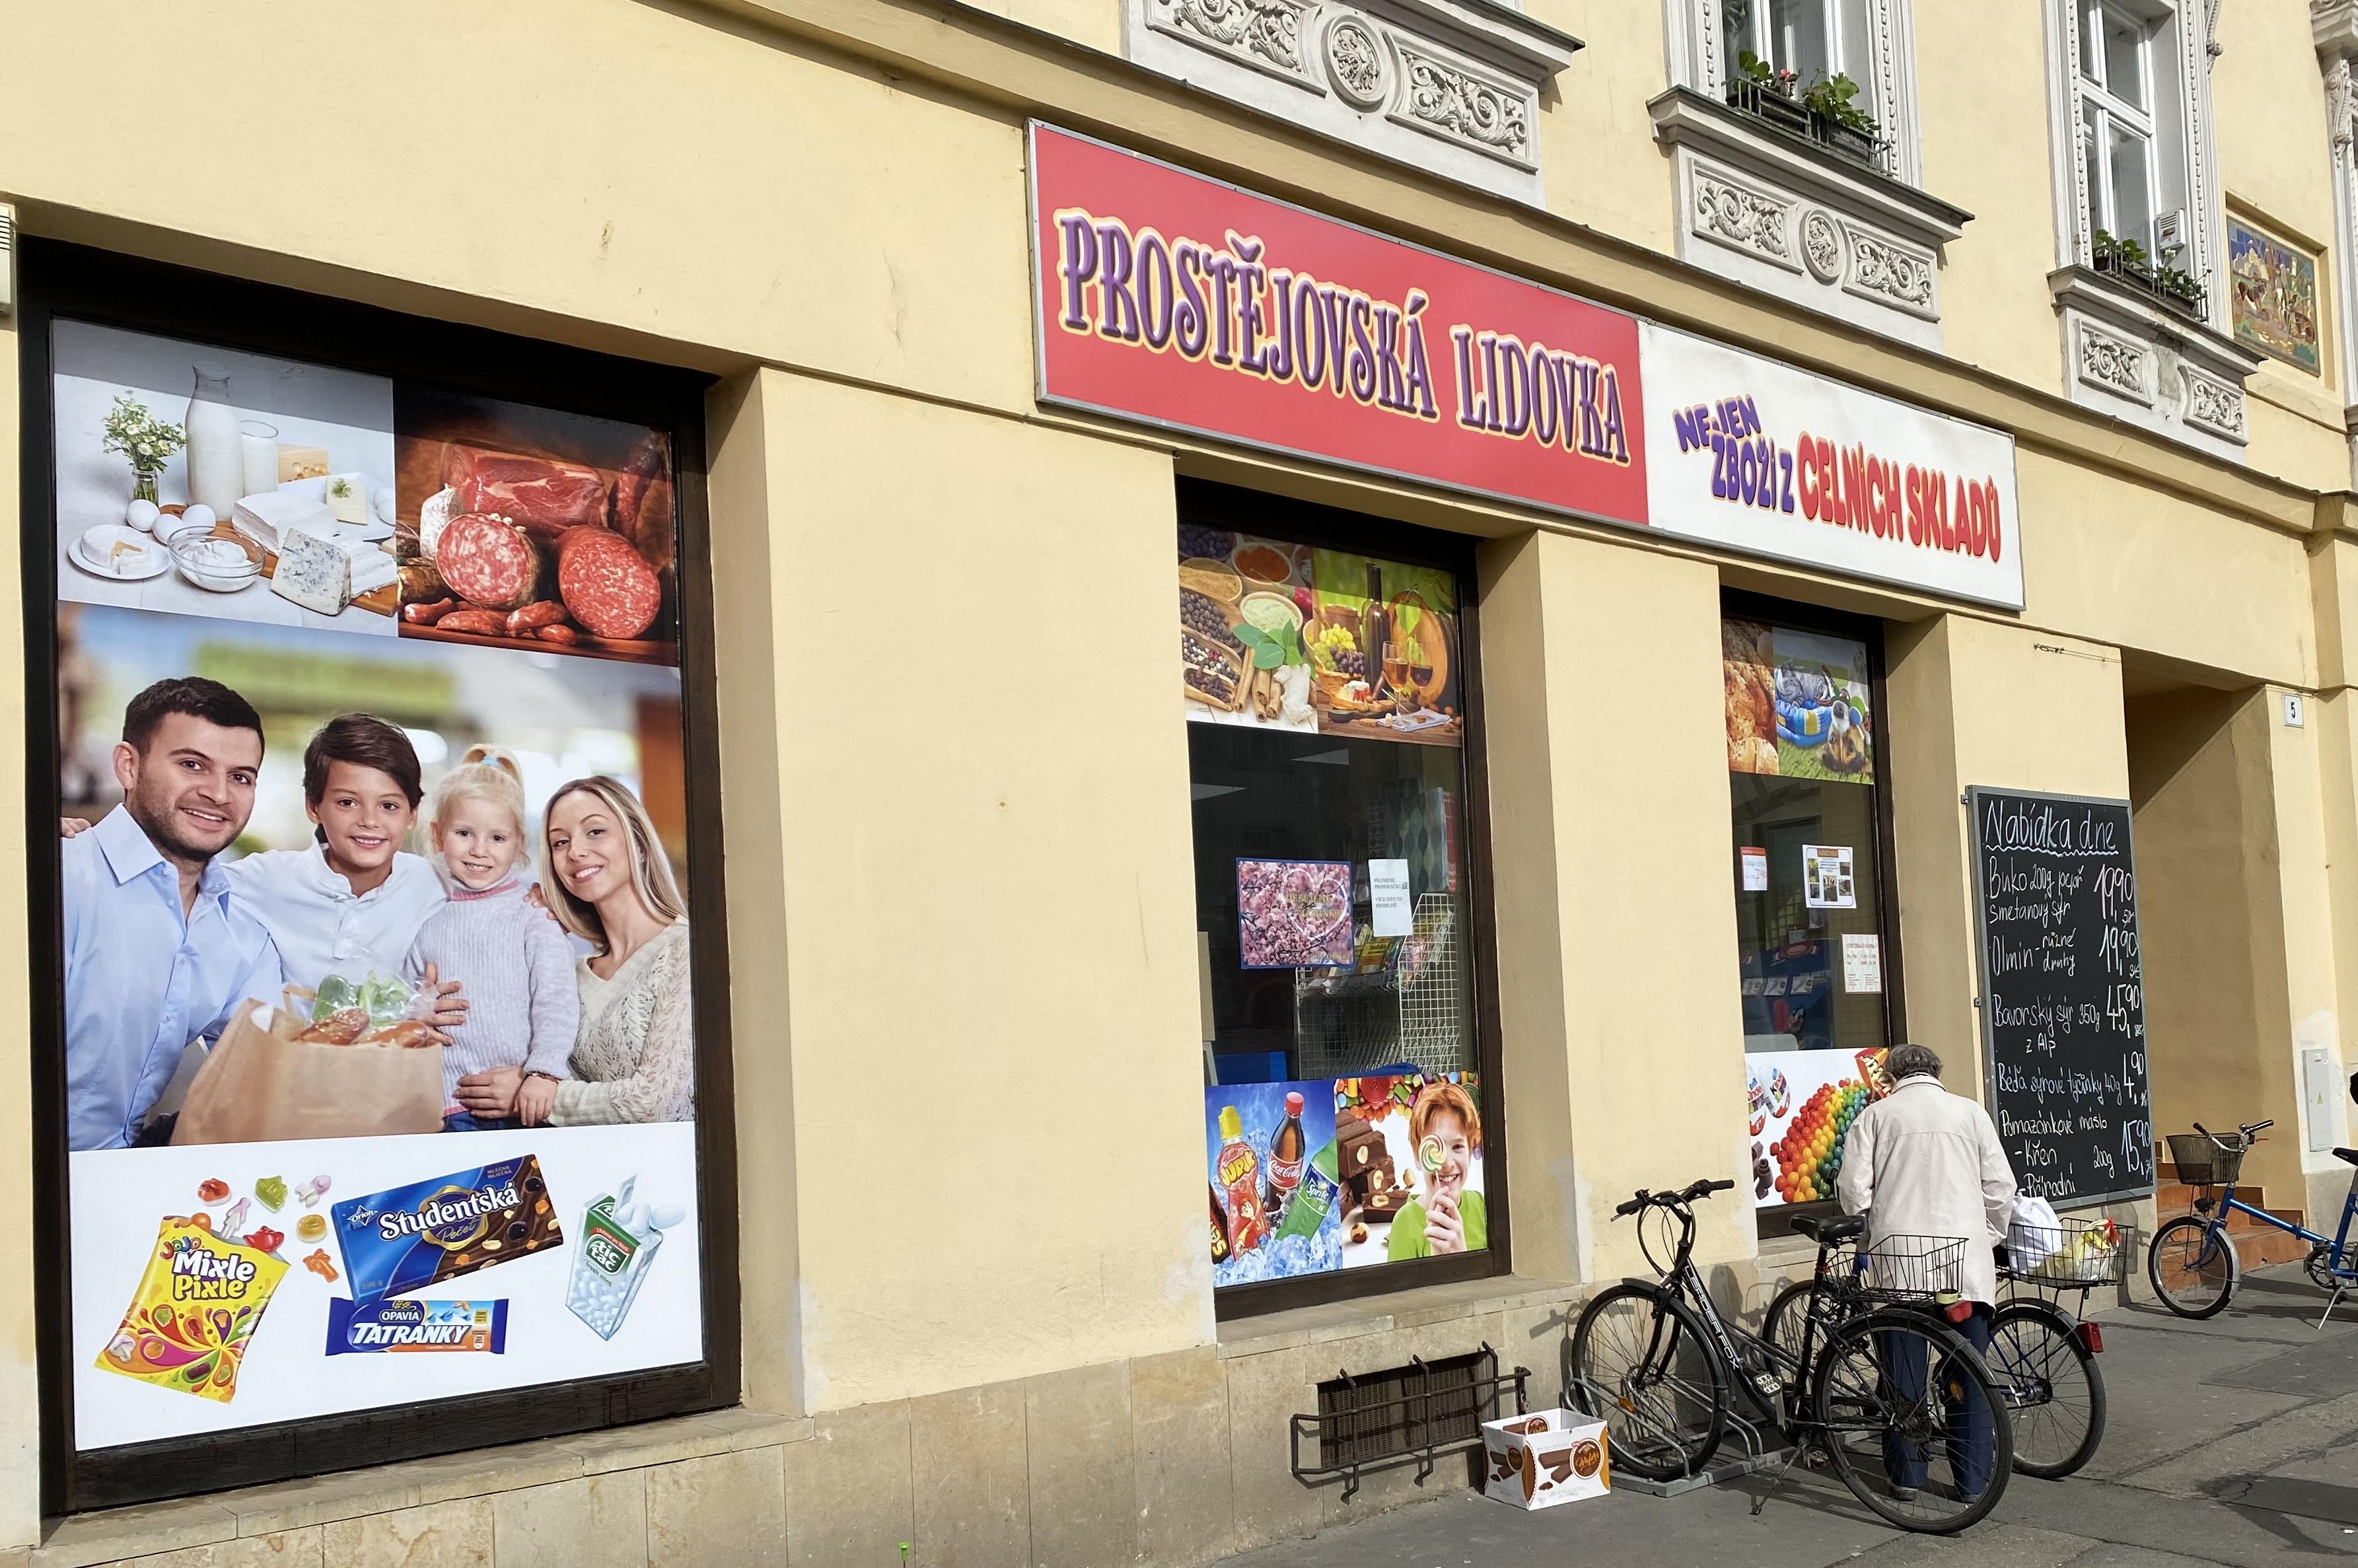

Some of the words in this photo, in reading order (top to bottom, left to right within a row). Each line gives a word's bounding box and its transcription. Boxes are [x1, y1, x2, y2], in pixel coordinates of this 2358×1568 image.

[1057, 213, 1439, 421] PROSTĚJOVSKÁ
[1452, 328, 1630, 465] LIDOVKA
[1672, 394, 1762, 453] NEJEN
[1779, 448, 1795, 515] Z
[1797, 431, 1904, 542] CELNÍCH
[1906, 463, 2001, 563] SKLADŮ
[2290, 701, 2296, 719] 5
[1985, 800, 2072, 849] Nabídka
[2079, 809, 2117, 850] dne
[1989, 856, 2027, 899] Buko
[2043, 950, 2076, 977] druhy
[1992, 993, 2054, 1038] Bavorský
[2056, 995, 2073, 1034] sýr
[2038, 1032, 2056, 1058] Alp
[1999, 1109, 2074, 1137] Pomazánkové
[1306, 1184, 1330, 1199] Sprite
[379, 1181, 521, 1240] Studentská
[172, 1250, 256, 1282] Mixle
[591, 1246, 615, 1271] tac
[598, 1240, 619, 1264] tic
[174, 1275, 245, 1300] Pixle
[382, 1311, 420, 1322] OPAVIA
[352, 1322, 470, 1345] TATRANKY
[1718, 1335, 1740, 1371] FOX
